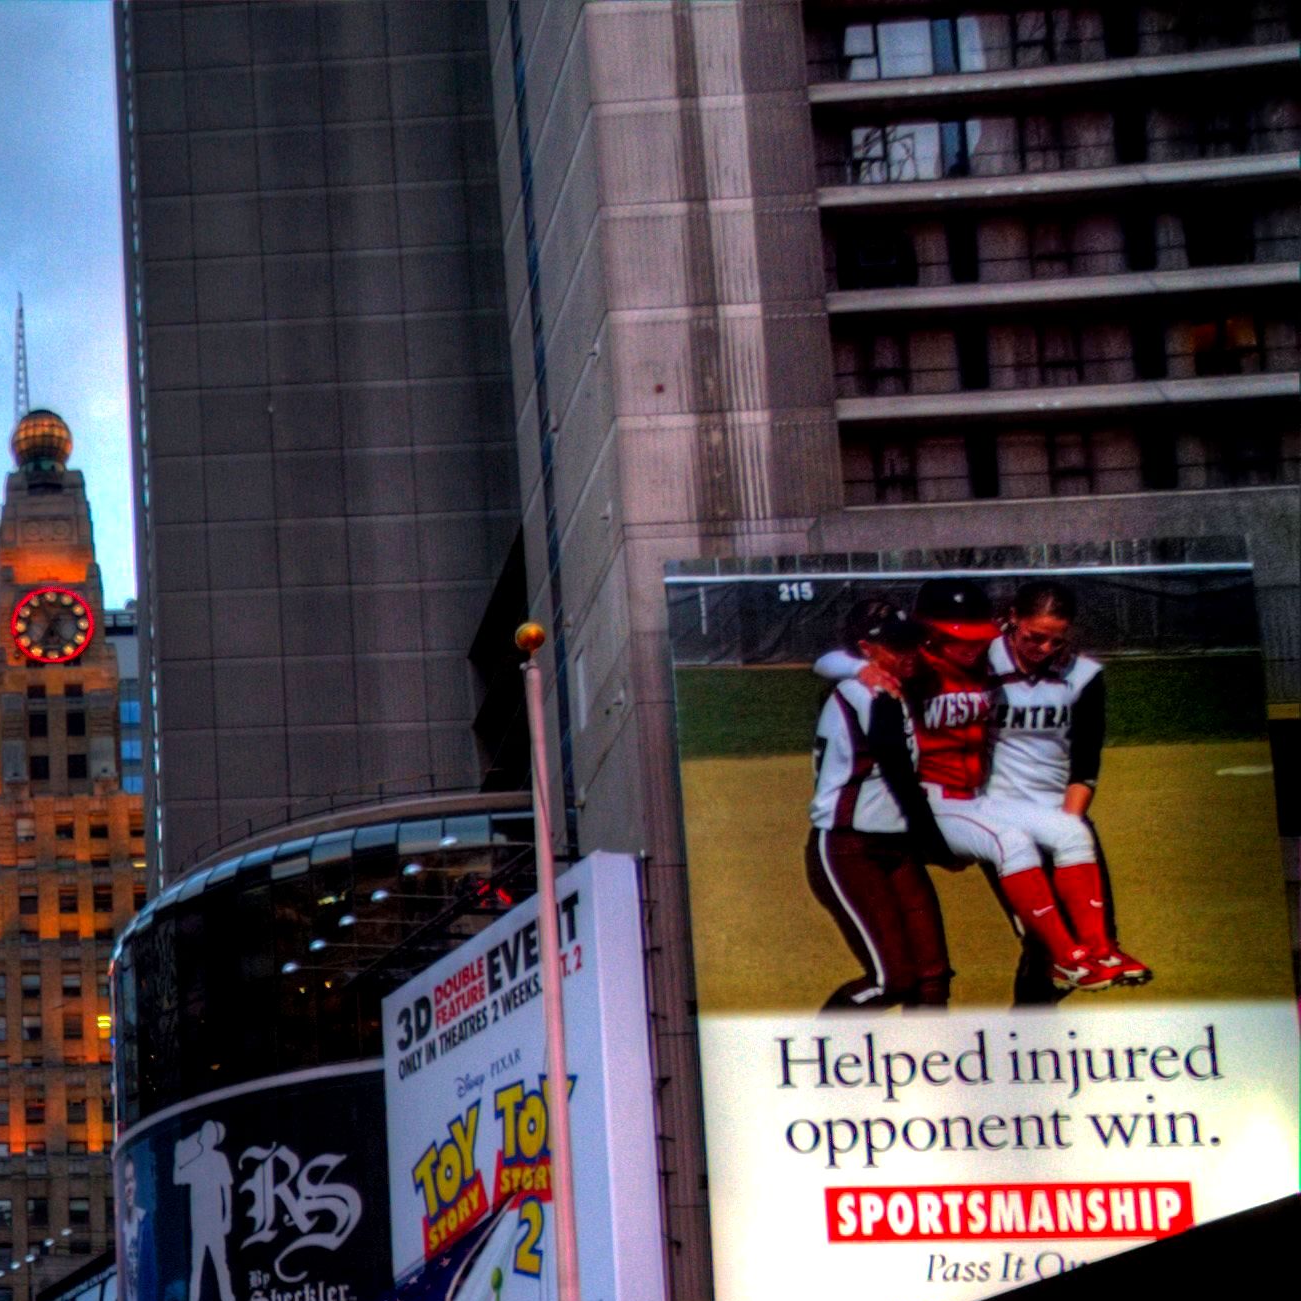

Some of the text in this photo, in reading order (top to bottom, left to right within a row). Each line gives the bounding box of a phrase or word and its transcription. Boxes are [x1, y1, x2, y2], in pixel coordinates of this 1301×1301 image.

[779, 583, 813, 600] 215
[397, 891, 581, 1050] 3D DOUBLE EVET
[435, 980, 486, 1029] FEATURE
[398, 1047, 423, 1081] ONLY
[425, 1042, 437, 1064] IN
[438, 1007, 488, 1056] THEATRES
[489, 1048, 522, 1078] PIXAR
[774, 1020, 1224, 1101] Helped injured
[412, 1098, 482, 1220] TOY
[785, 1093, 1222, 1169] opponent win.
[427, 1184, 481, 1252] STORY
[513, 1195, 545, 1279] 2
[836, 1186, 1184, 1237] SPORTSMANSHIP
[926, 1253, 992, 1283] Pass
[999, 1251, 1027, 1283] It
